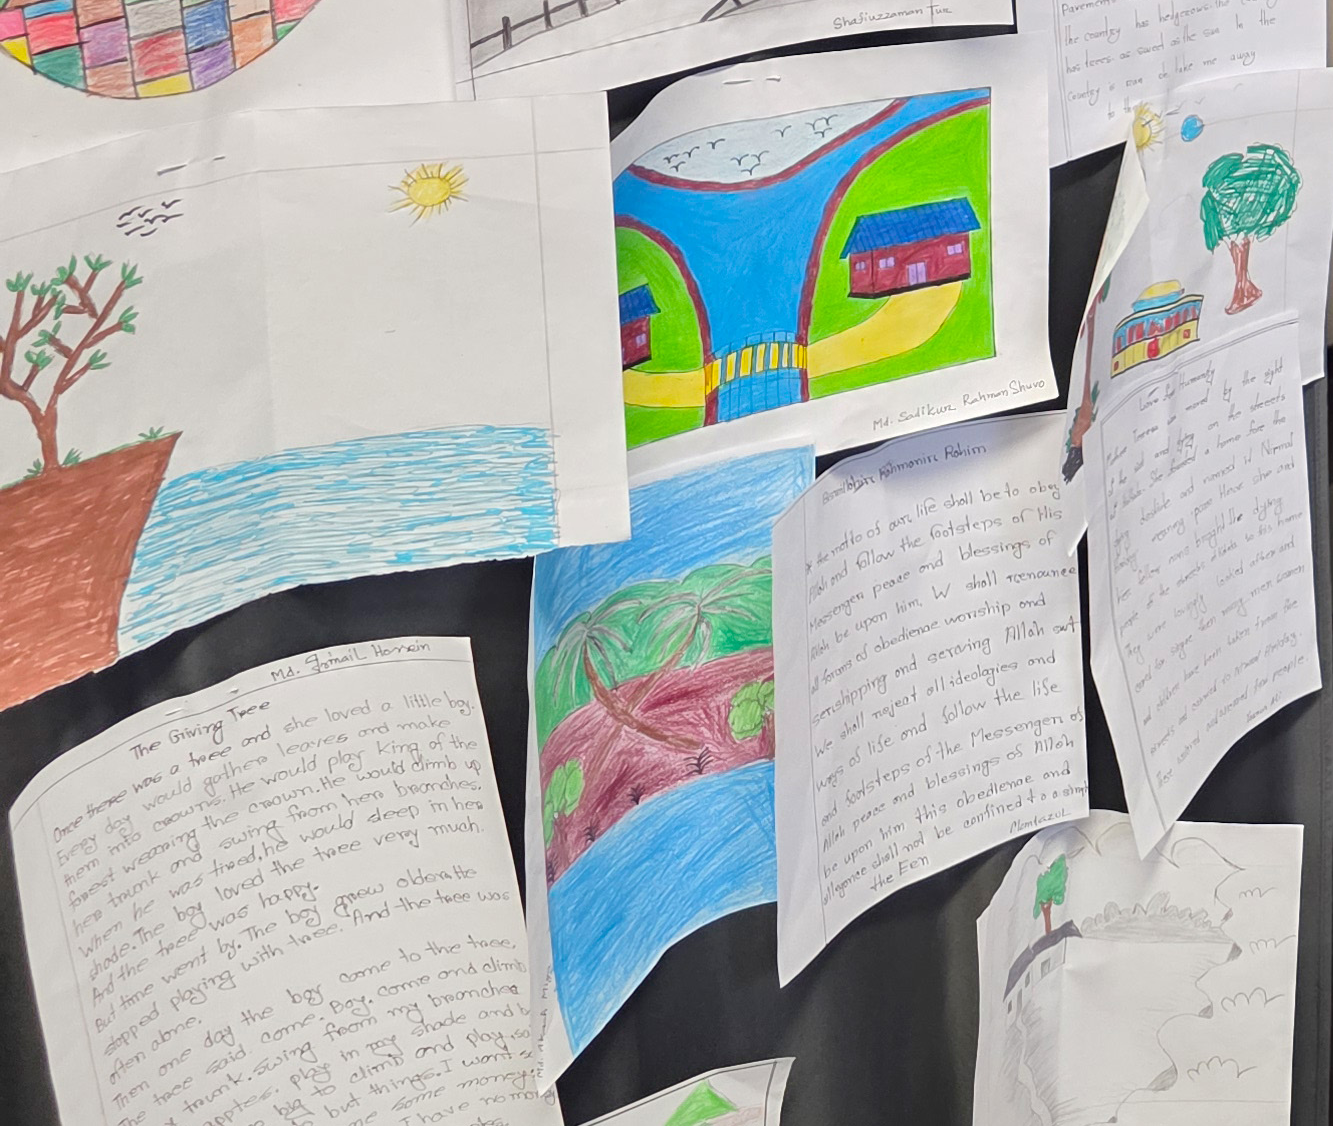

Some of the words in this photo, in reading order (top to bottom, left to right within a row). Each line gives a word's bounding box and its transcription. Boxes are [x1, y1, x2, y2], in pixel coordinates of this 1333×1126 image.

[1009, 379, 1045, 395] Shuvo
[916, 497, 938, 517] life
[900, 537, 925, 553] the
[242, 724, 271, 747] and
[283, 717, 318, 734] she
[324, 699, 371, 722] loved
[381, 702, 392, 712] a
[403, 693, 442, 709] little
[994, 689, 1024, 706] the
[129, 740, 162, 760] The
[168, 720, 224, 745] Giving
[227, 701, 270, 722] Tree
[142, 777, 192, 811] would
[276, 733, 348, 757] leaves
[358, 725, 390, 738] and
[396, 715, 452, 731] make
[202, 811, 239, 830] the
[320, 775, 346, 790] He
[357, 760, 406, 781] would
[411, 753, 457, 772] climb
[464, 759, 481, 775] up
[108, 832, 142, 855] into
[229, 781, 255, 799] He
[260, 754, 317, 785] would
[328, 749, 365, 774] play
[429, 732, 446, 749] of
[449, 734, 478, 749] the
[133, 899, 154, 921] he
[169, 876, 204, 899] was
[299, 810, 354, 842] would
[430, 800, 449, 812] in
[170, 852, 202, 873] and
[219, 819, 289, 850] swing
[133, 923, 165, 945] The
[173, 901, 207, 930] boy
[215, 874, 264, 901] loved
[270, 854, 305, 876] the
[427, 816, 485, 836] much.
[394, 897, 431, 912] the
[117, 957, 149, 981] the
[209, 904, 250, 932] was
[158, 1047, 192, 1077] one
[203, 1025, 236, 1048] day
[240, 1006, 274, 1026] the
[398, 947, 421, 962] to
